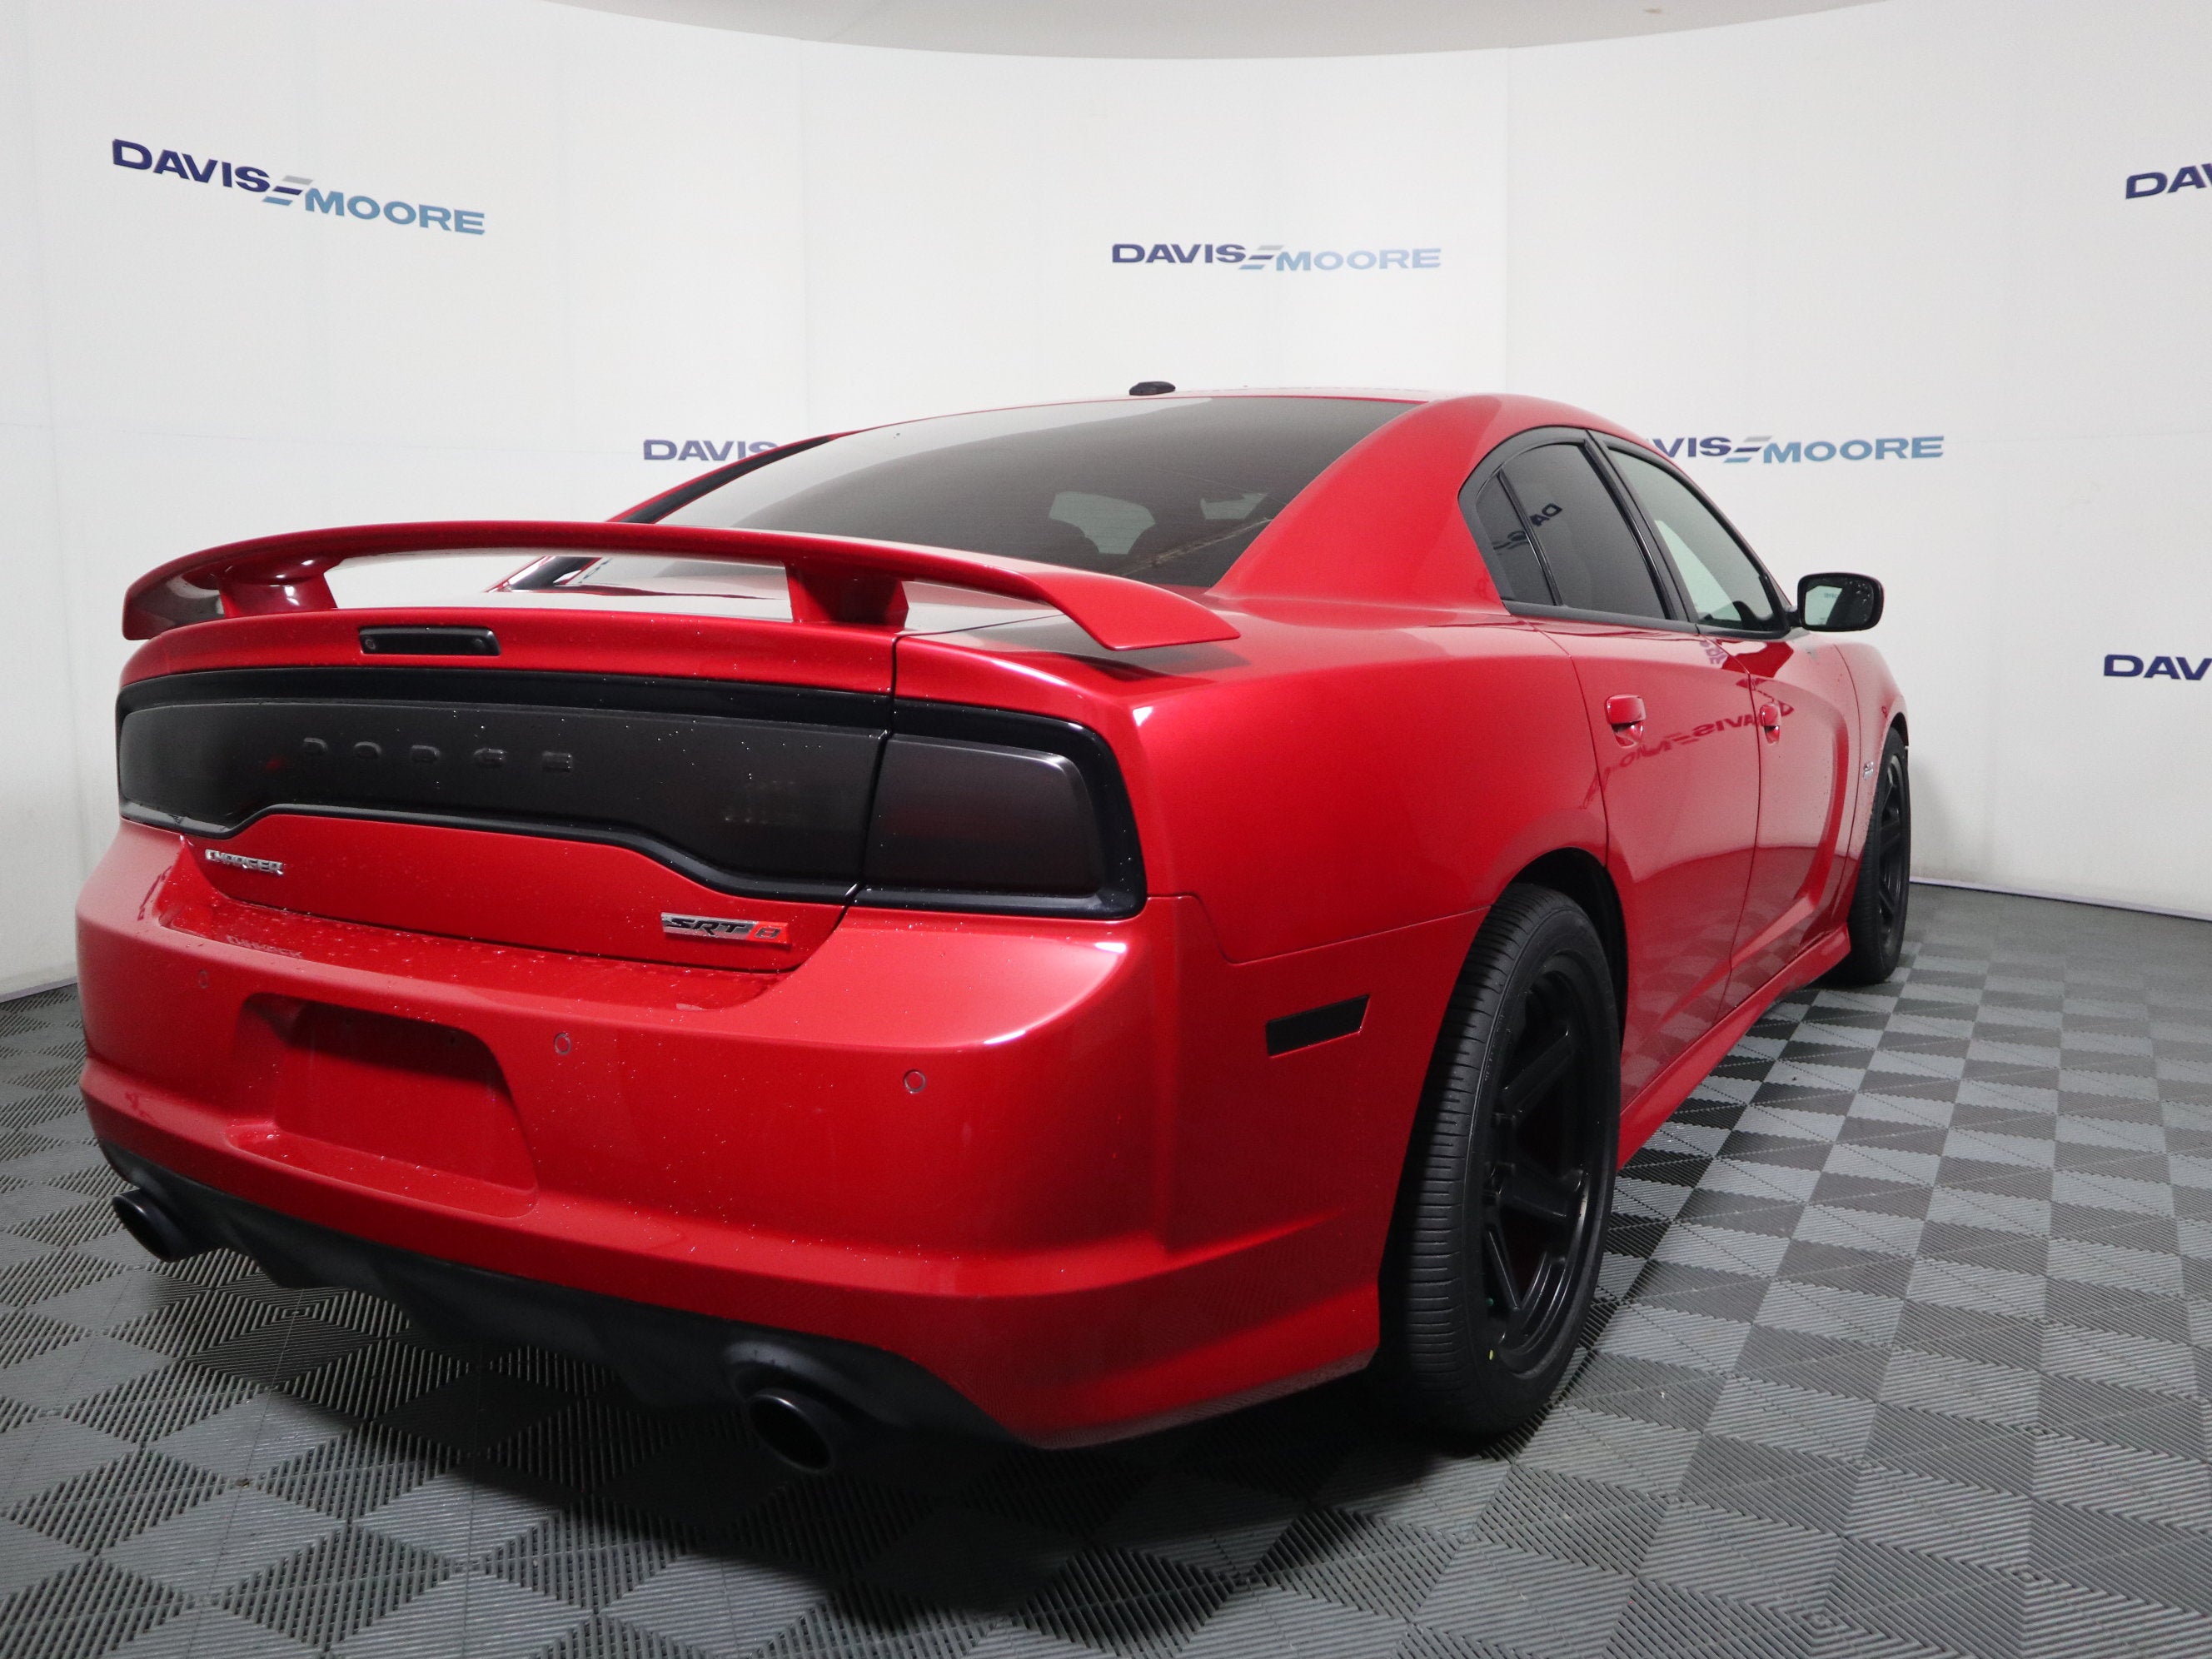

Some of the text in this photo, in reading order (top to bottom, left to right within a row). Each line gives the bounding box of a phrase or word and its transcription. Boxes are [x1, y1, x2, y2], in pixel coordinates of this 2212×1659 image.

[112, 138, 486, 236] DAVIS MOORE
[1111, 242, 1442, 272] DAVIS MOORE
[1652, 435, 1945, 464] VIS MOORE
